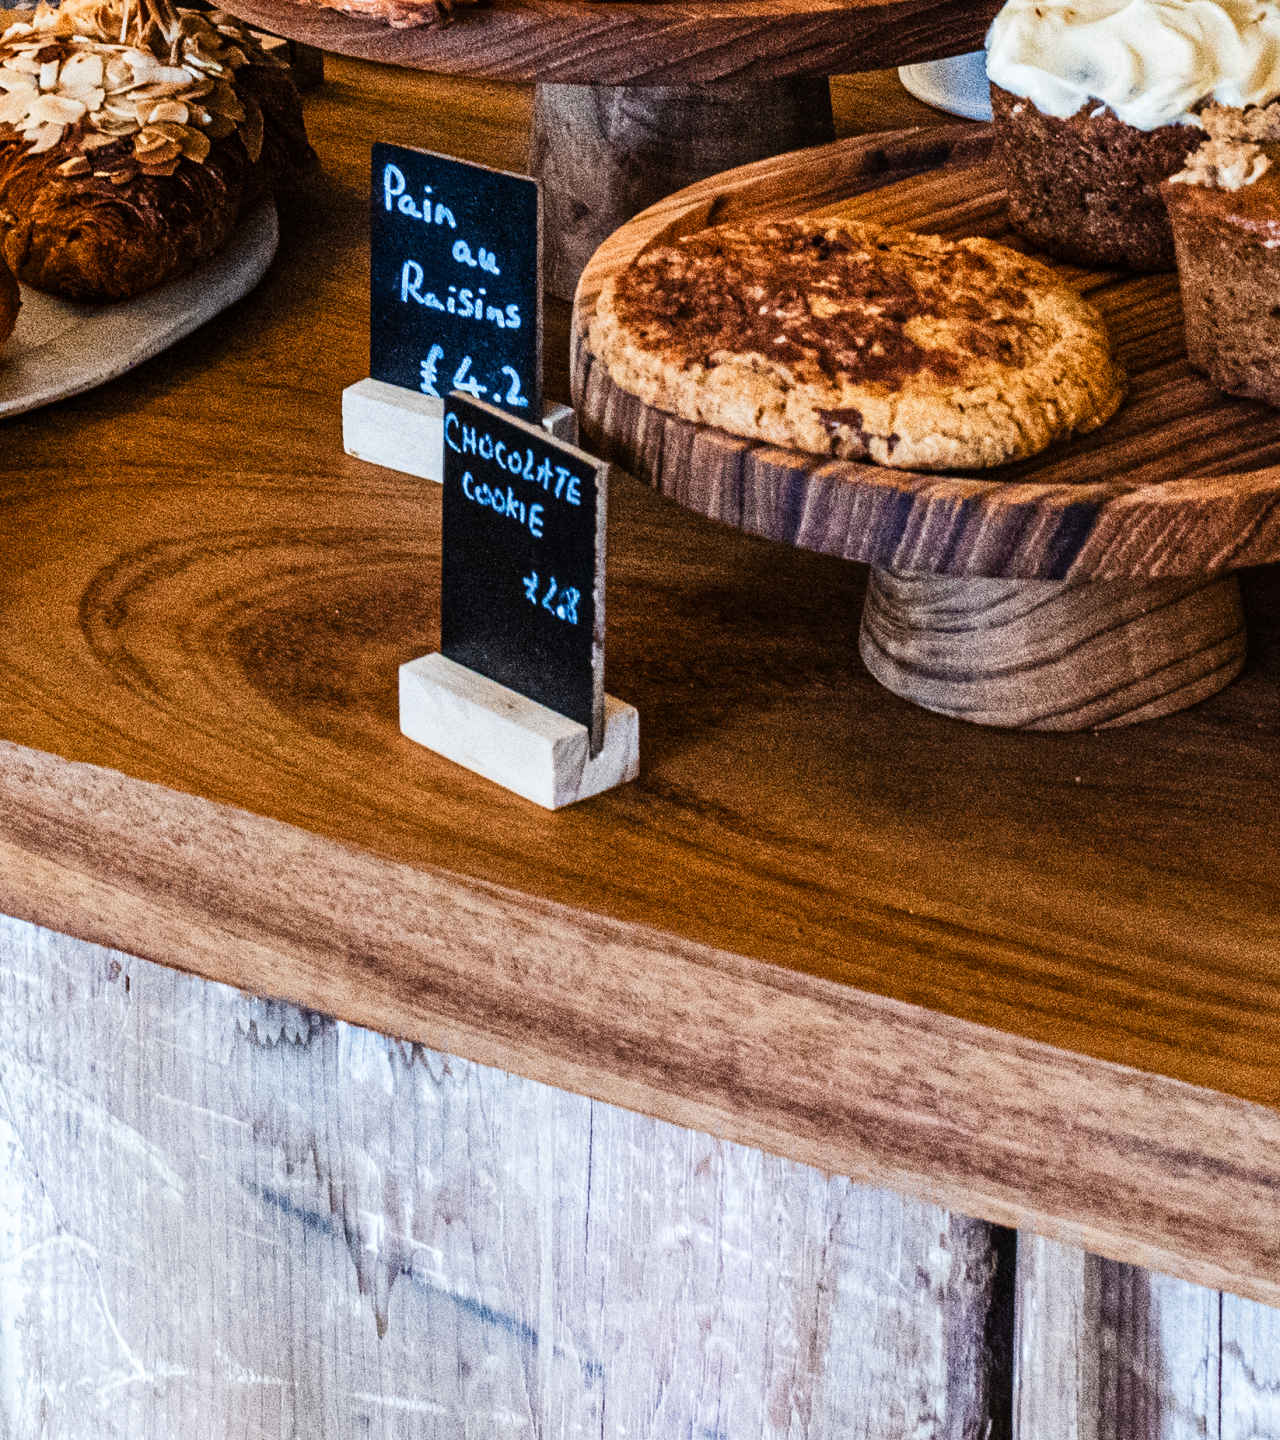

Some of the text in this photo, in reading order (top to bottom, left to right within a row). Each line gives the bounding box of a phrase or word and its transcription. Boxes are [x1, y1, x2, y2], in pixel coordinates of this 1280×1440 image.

[383, 163, 457, 230] Pain
[452, 240, 500, 275] au
[401, 260, 520, 328] Raisins
[445, 412, 581, 505] CHOCOLATE
[462, 471, 544, 537] COOKIE
